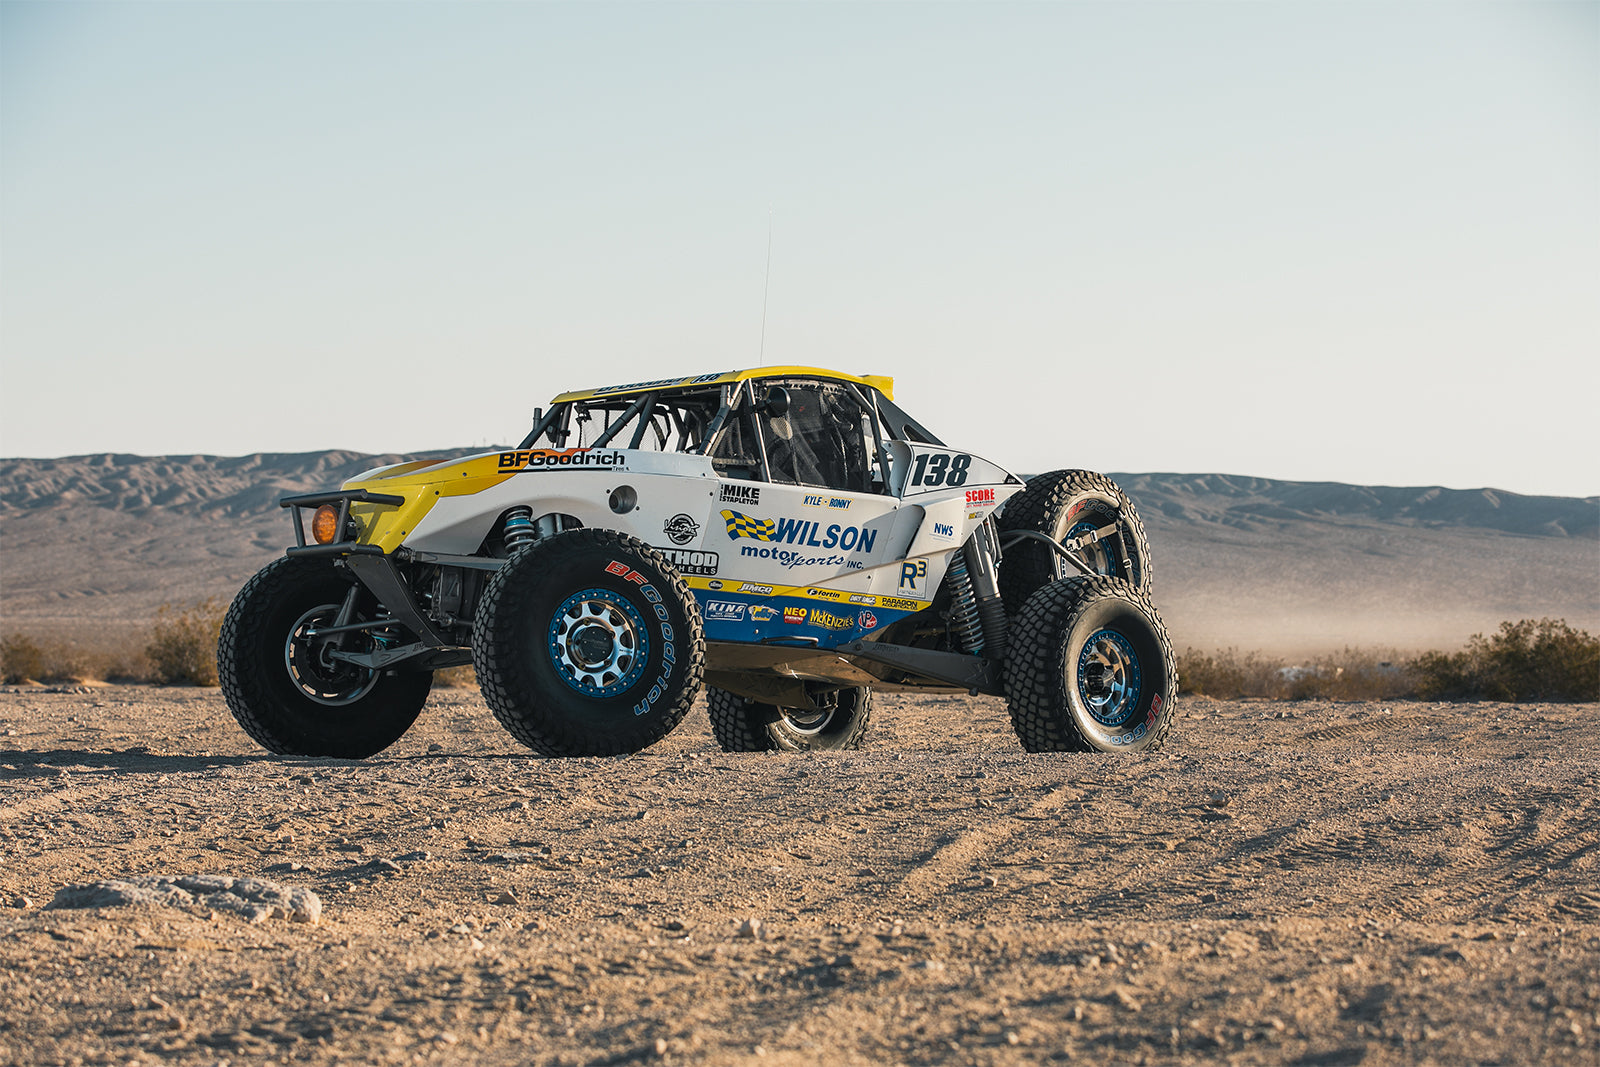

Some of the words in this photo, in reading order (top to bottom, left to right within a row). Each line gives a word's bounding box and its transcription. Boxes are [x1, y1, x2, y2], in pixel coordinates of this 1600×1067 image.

[499, 451, 625, 467] BFGoodrich
[911, 454, 972, 487] 138
[723, 484, 760, 499] MIKE
[965, 488, 995, 502] SCORE
[722, 495, 759, 505] STAPLETON
[803, 495, 822, 505] KYLE
[828, 498, 851, 509] RONNY
[776, 518, 877, 553] WILSON
[934, 522, 953, 536] NWS
[741, 546, 798, 560] motor
[780, 555, 844, 569] sports
[847, 560, 864, 569] INC.
[818, 590, 840, 598] fortin
[783, 606, 807, 617] NEO
[604, 560, 676, 716] BFGoodrich
